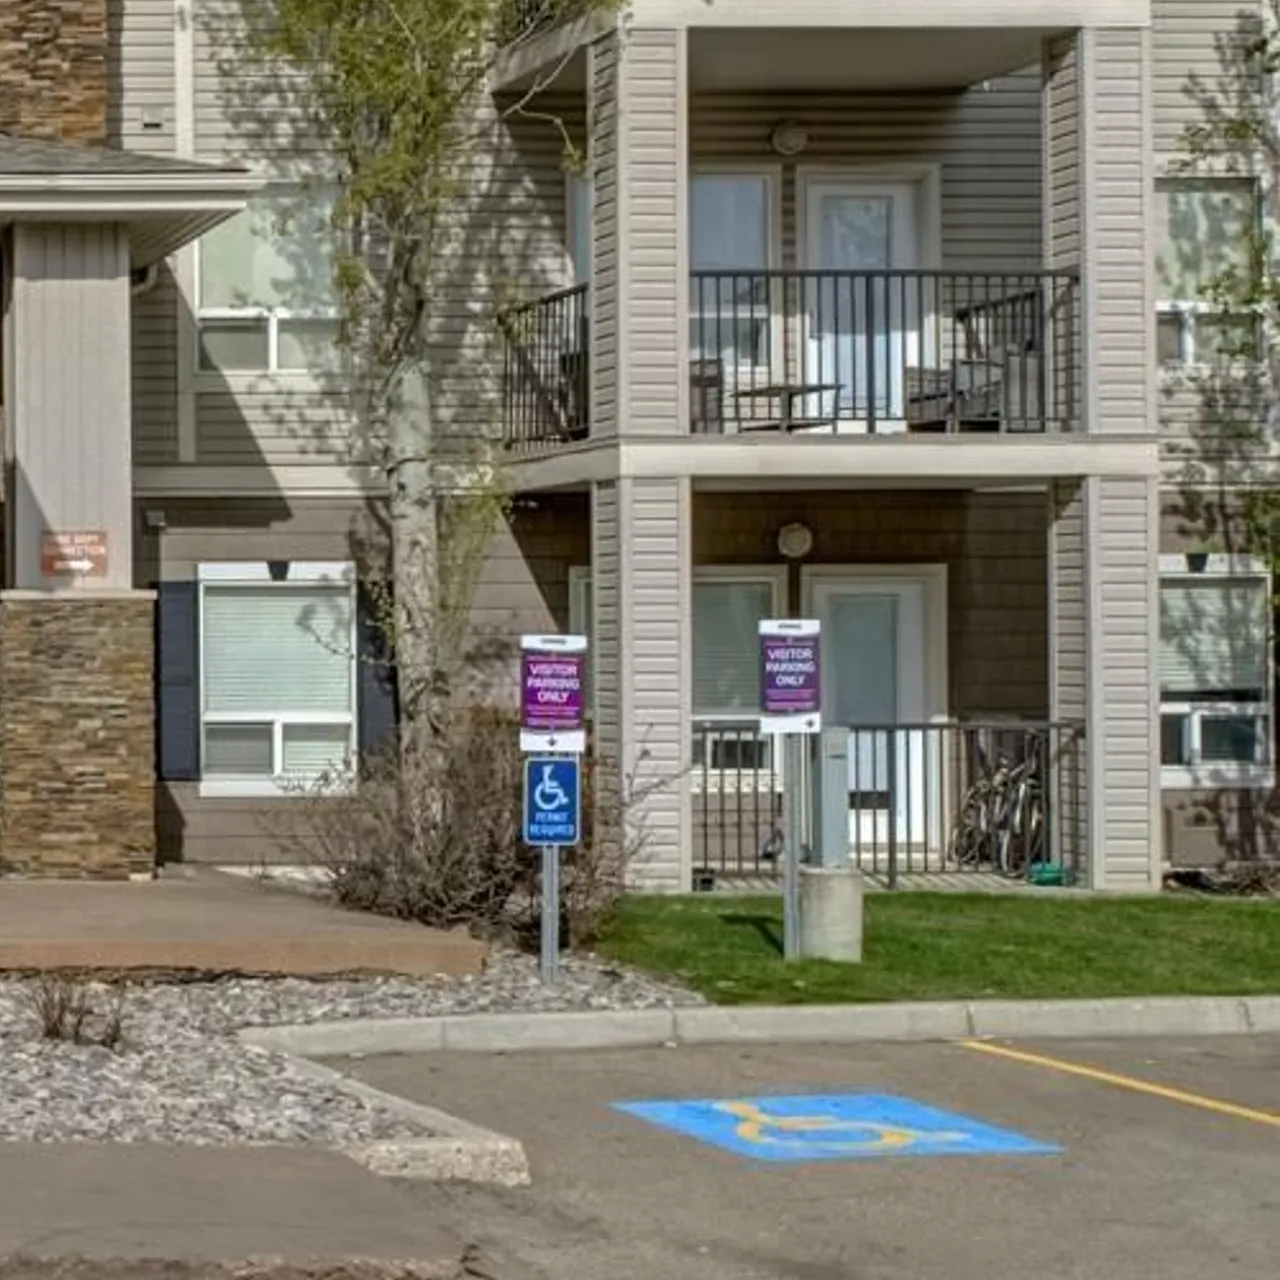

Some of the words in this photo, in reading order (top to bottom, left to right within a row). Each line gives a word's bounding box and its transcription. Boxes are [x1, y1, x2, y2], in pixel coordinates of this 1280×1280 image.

[766, 647, 814, 660] VISITOR
[529, 663, 578, 676] VISITOR
[765, 661, 816, 673] PARKING
[526, 677, 580, 690] PARKING
[776, 674, 805, 687] ONLY
[537, 691, 571, 704] ONLY
